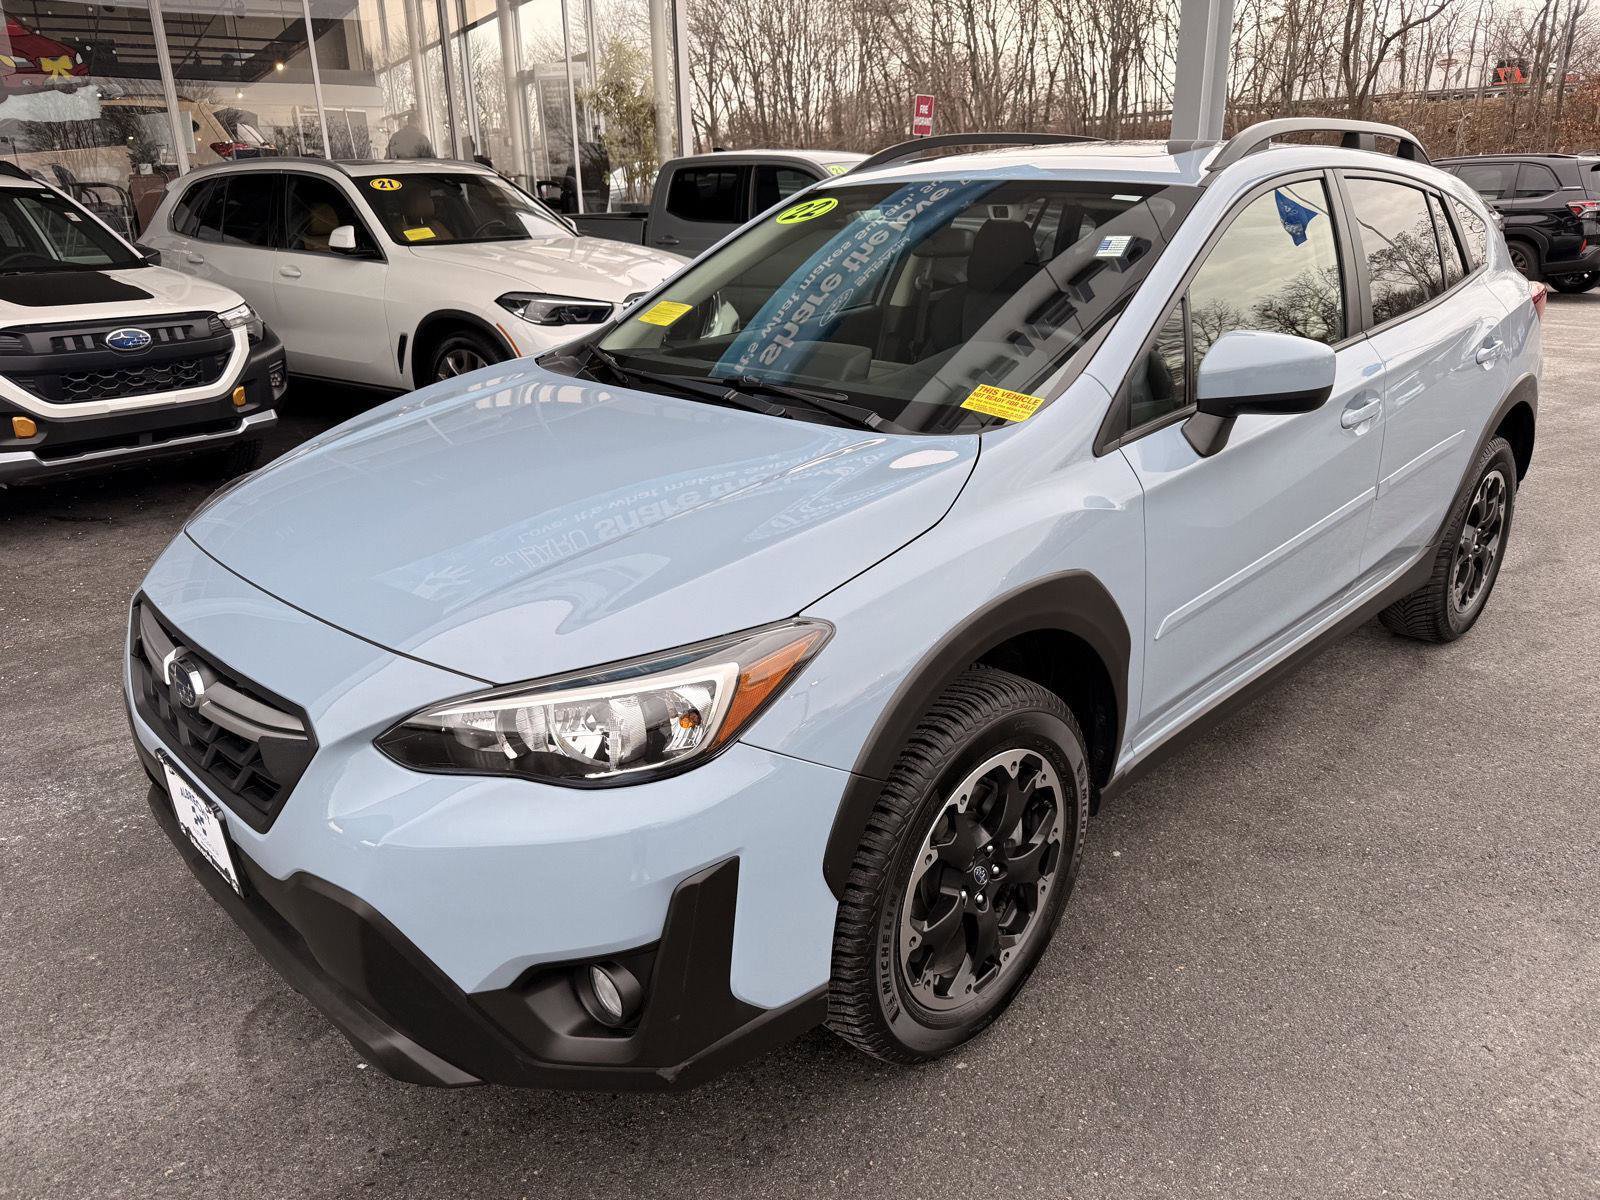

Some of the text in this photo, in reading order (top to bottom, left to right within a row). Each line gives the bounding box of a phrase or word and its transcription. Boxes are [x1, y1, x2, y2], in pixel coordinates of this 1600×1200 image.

[378, 180, 394, 189] 21
[781, 201, 832, 220] 22
[979, 386, 1040, 405] THIS VEHICLE
[985, 394, 1006, 404] READY
[1006, 399, 1020, 407] FOR
[1019, 403, 1036, 411] SALE
[880, 894, 899, 995] MICHELIN
